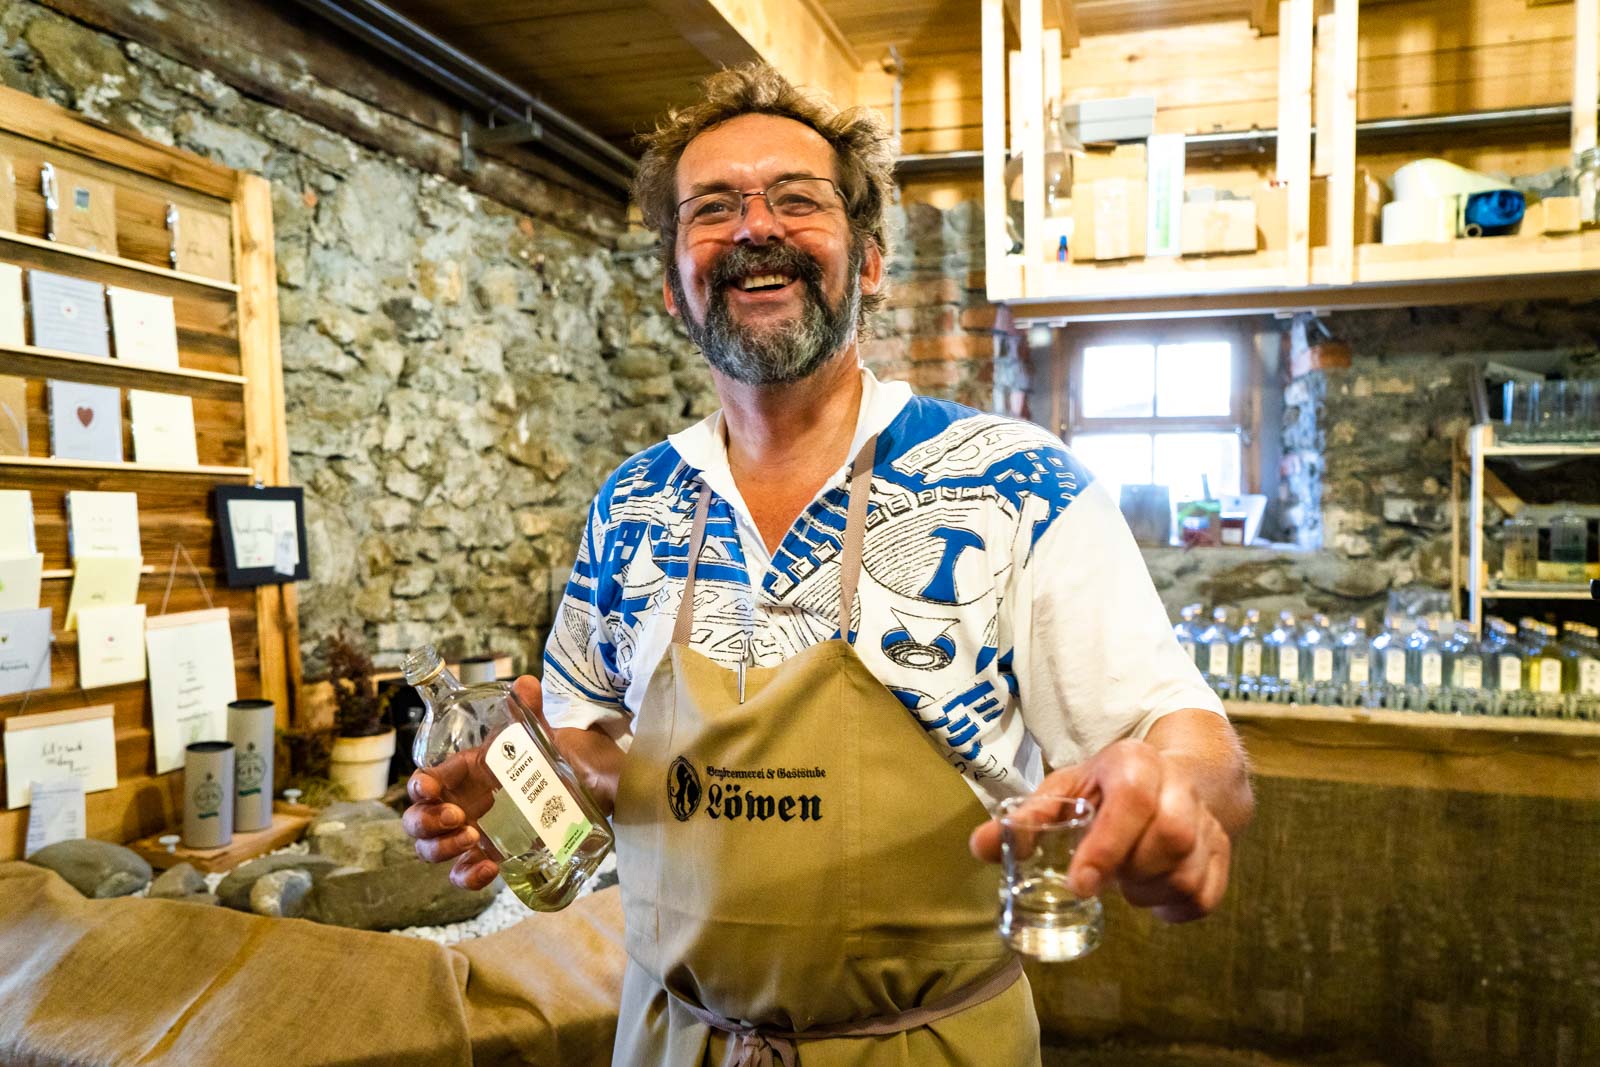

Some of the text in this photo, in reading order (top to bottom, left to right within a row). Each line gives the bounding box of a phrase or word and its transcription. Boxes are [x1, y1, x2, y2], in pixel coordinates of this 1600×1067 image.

[509, 755, 534, 782] Löwen
[766, 768, 776, 779] &
[776, 766, 826, 779] Gaststube
[520, 769, 543, 795] BERGHEU
[526, 778, 549, 804] SCHNAPS
[704, 783, 823, 822] Löwen
